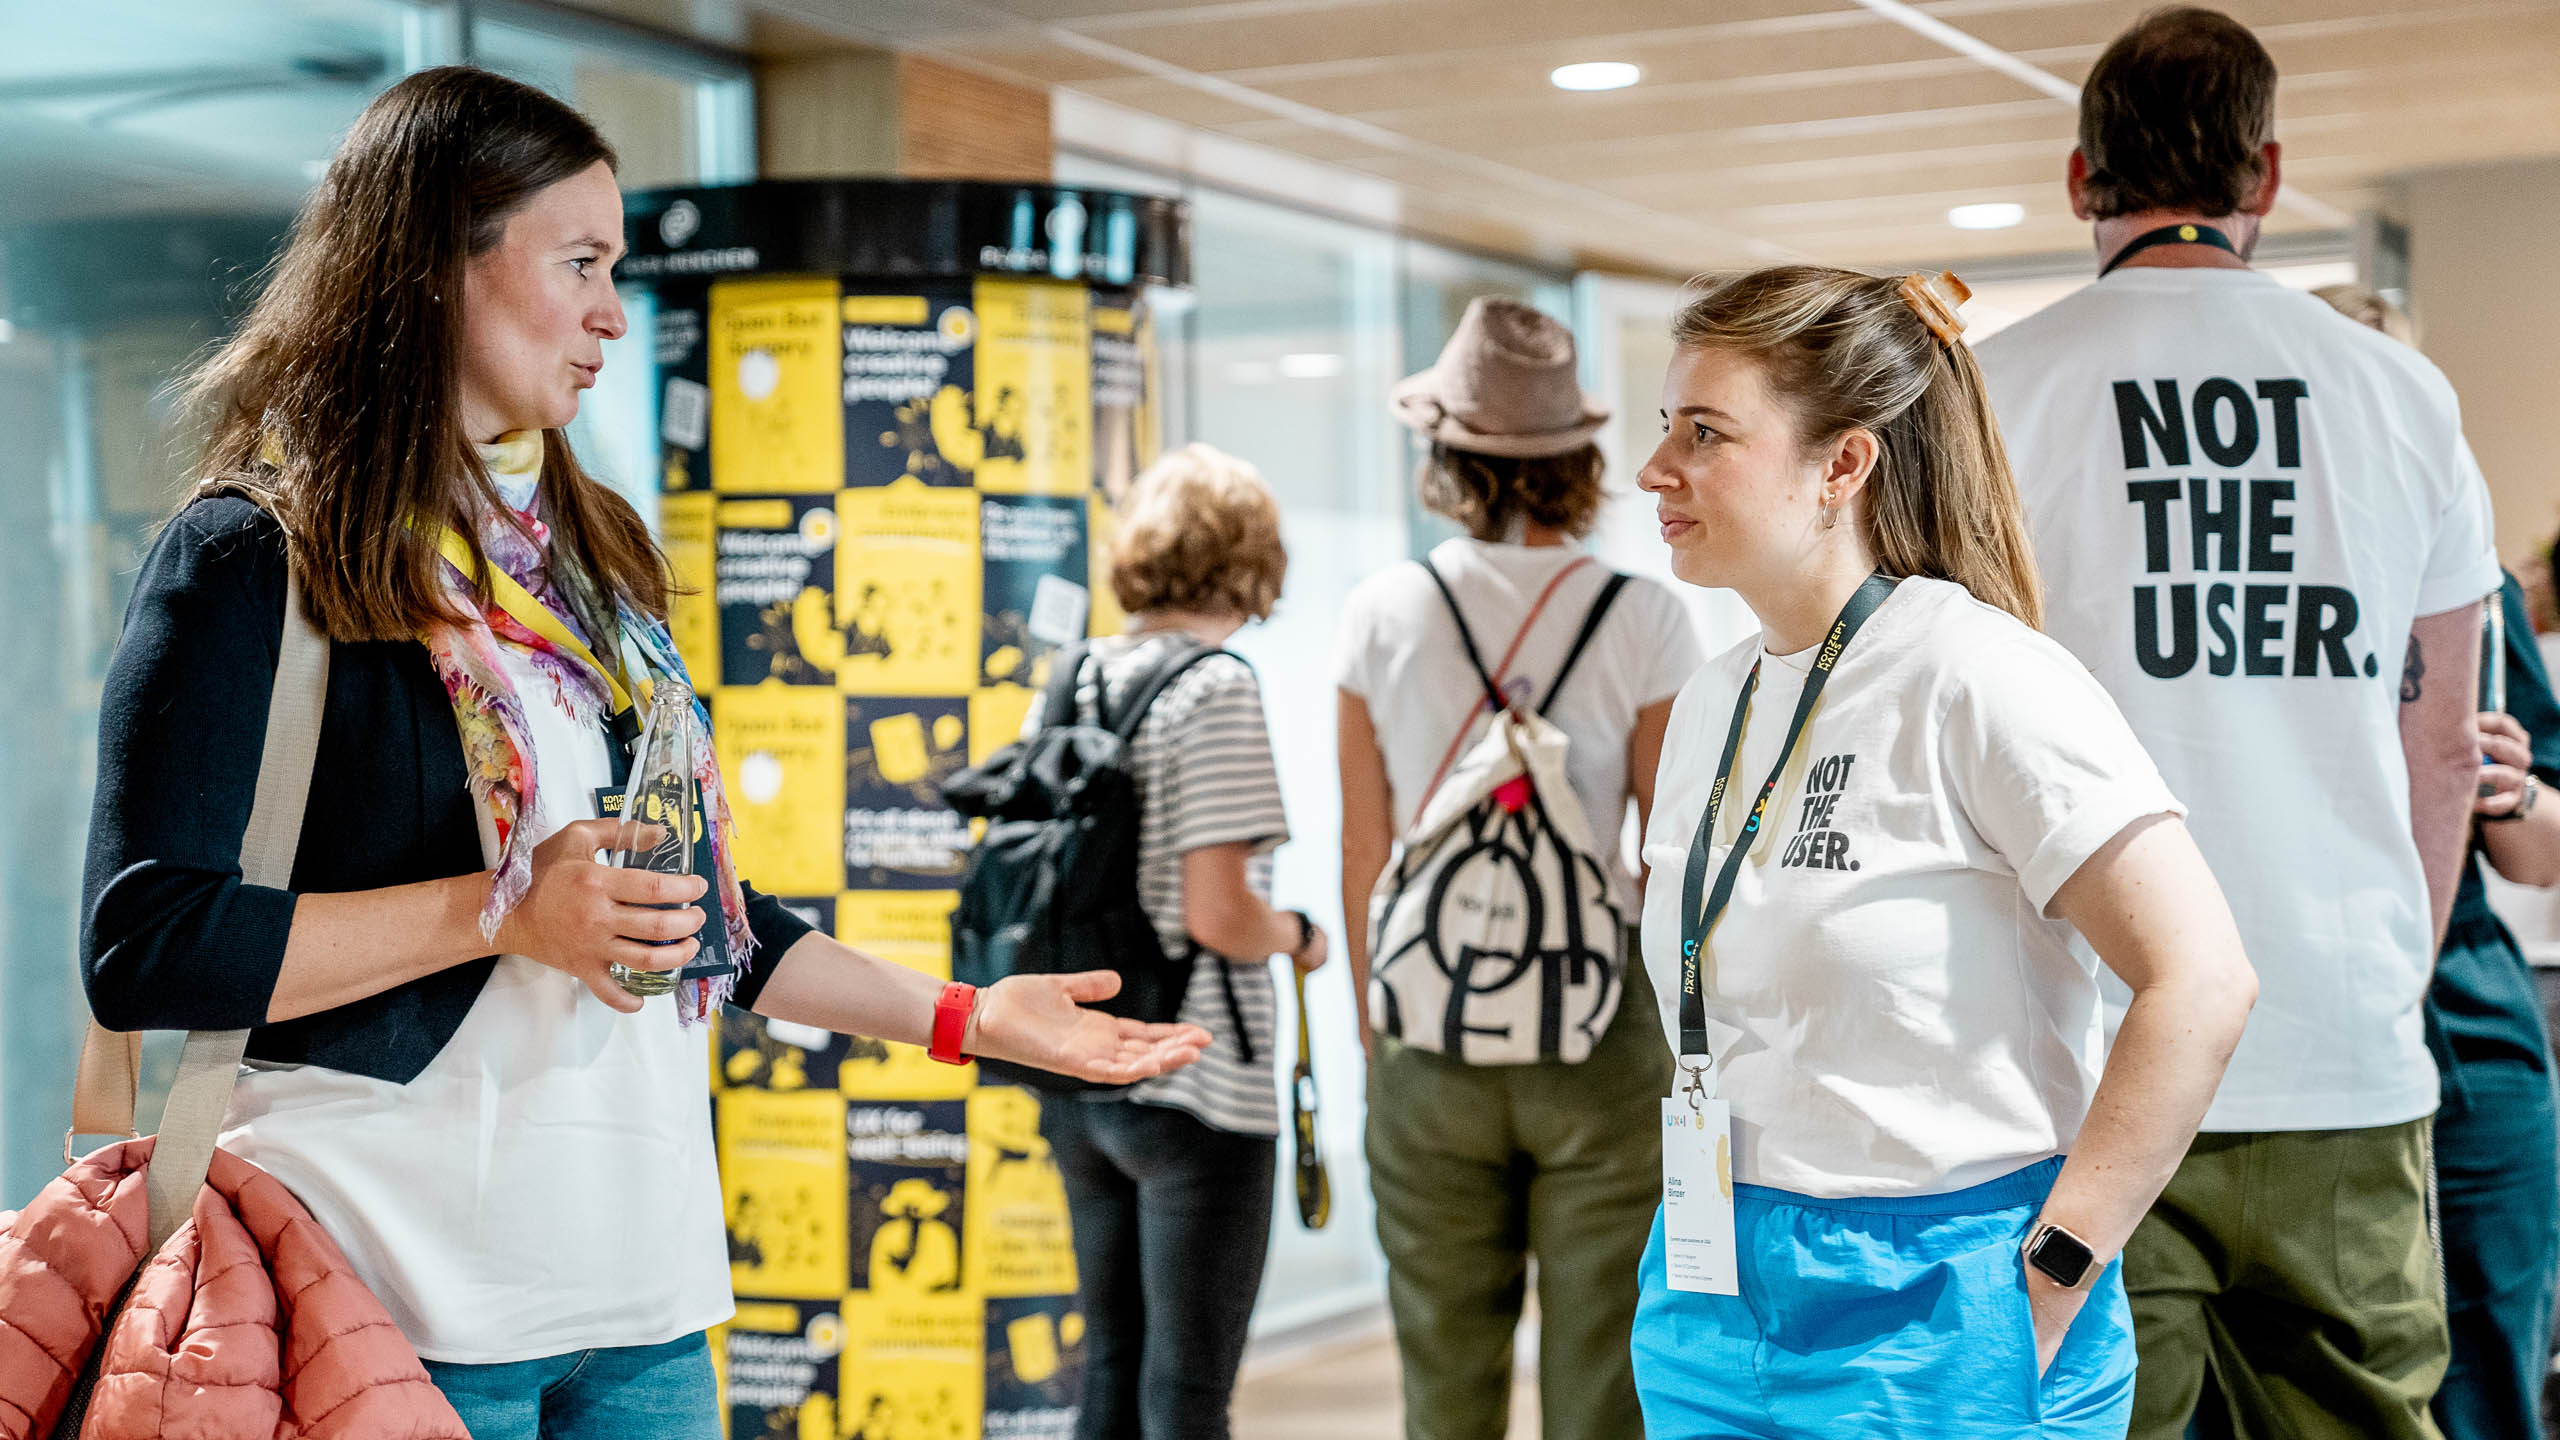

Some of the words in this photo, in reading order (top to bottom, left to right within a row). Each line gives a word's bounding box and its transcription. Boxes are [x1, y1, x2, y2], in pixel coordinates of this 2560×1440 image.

[2112, 377, 2309, 469] NOT
[2126, 478, 2295, 572] THE
[2133, 582, 2378, 679] USER.
[1806, 754, 1856, 794] NOT
[1799, 793, 1842, 832] THE
[1781, 831, 1861, 872] USER.
